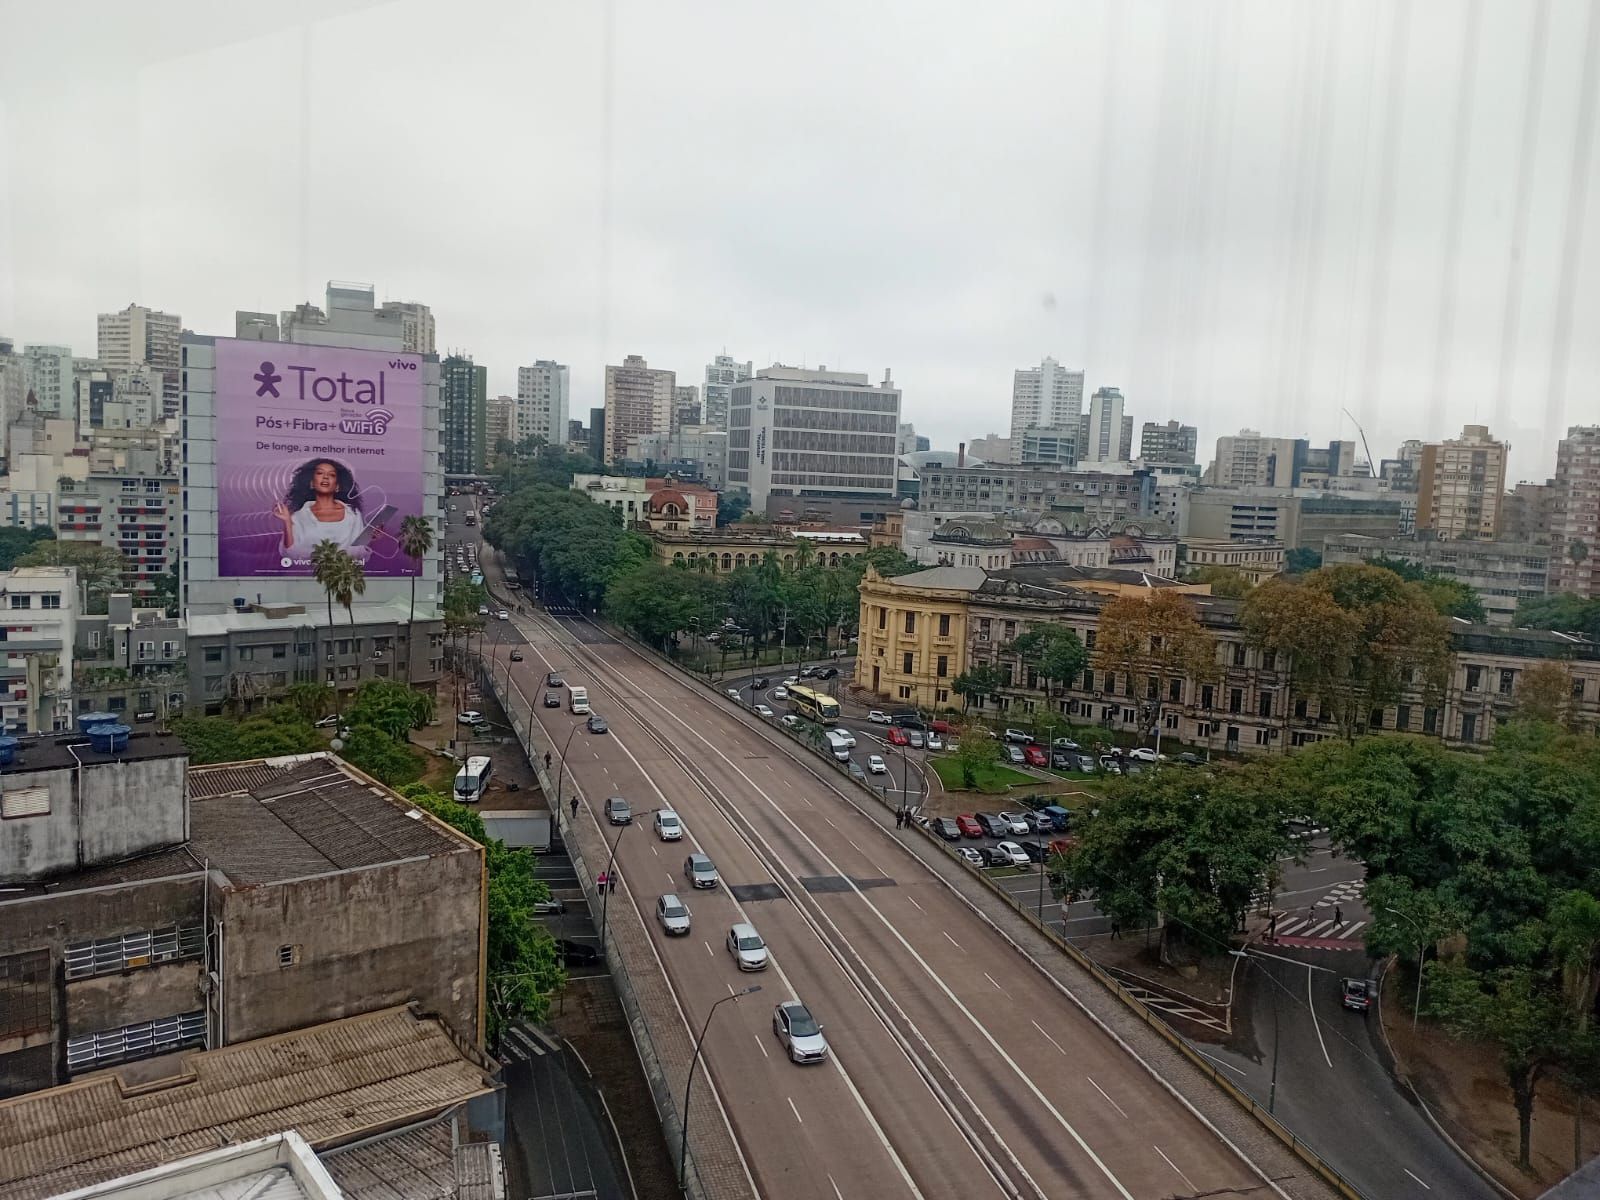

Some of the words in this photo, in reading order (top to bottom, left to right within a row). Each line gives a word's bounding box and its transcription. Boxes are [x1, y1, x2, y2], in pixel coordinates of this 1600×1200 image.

[388, 359, 417, 371] vivo
[287, 365, 385, 405] Total
[256, 441, 270, 450] De
[272, 442, 301, 453] longe,
[312, 444, 345, 454] melhor
[347, 447, 385, 456] internet
